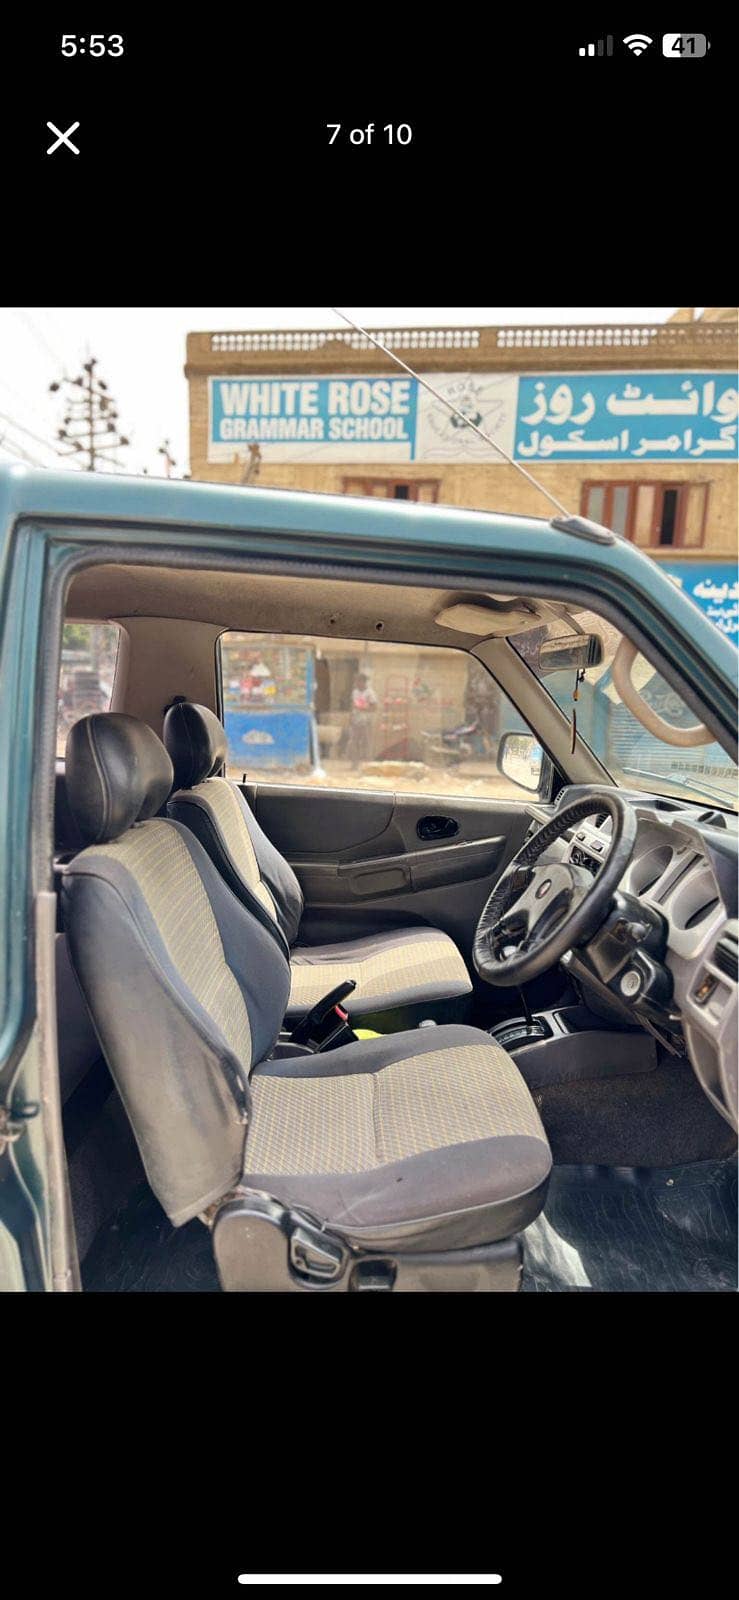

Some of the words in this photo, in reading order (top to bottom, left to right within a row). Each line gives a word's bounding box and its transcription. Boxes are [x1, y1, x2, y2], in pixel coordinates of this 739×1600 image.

[219, 382, 319, 416] WHITE
[328, 380, 410, 415] ROSE
[520, 381, 596, 426] روز
[219, 417, 324, 441] GRAMMAR
[328, 416, 409, 440] SCHOOL
[517, 428, 630, 458] اسکول
[631, 425, 738, 457] گرامر
